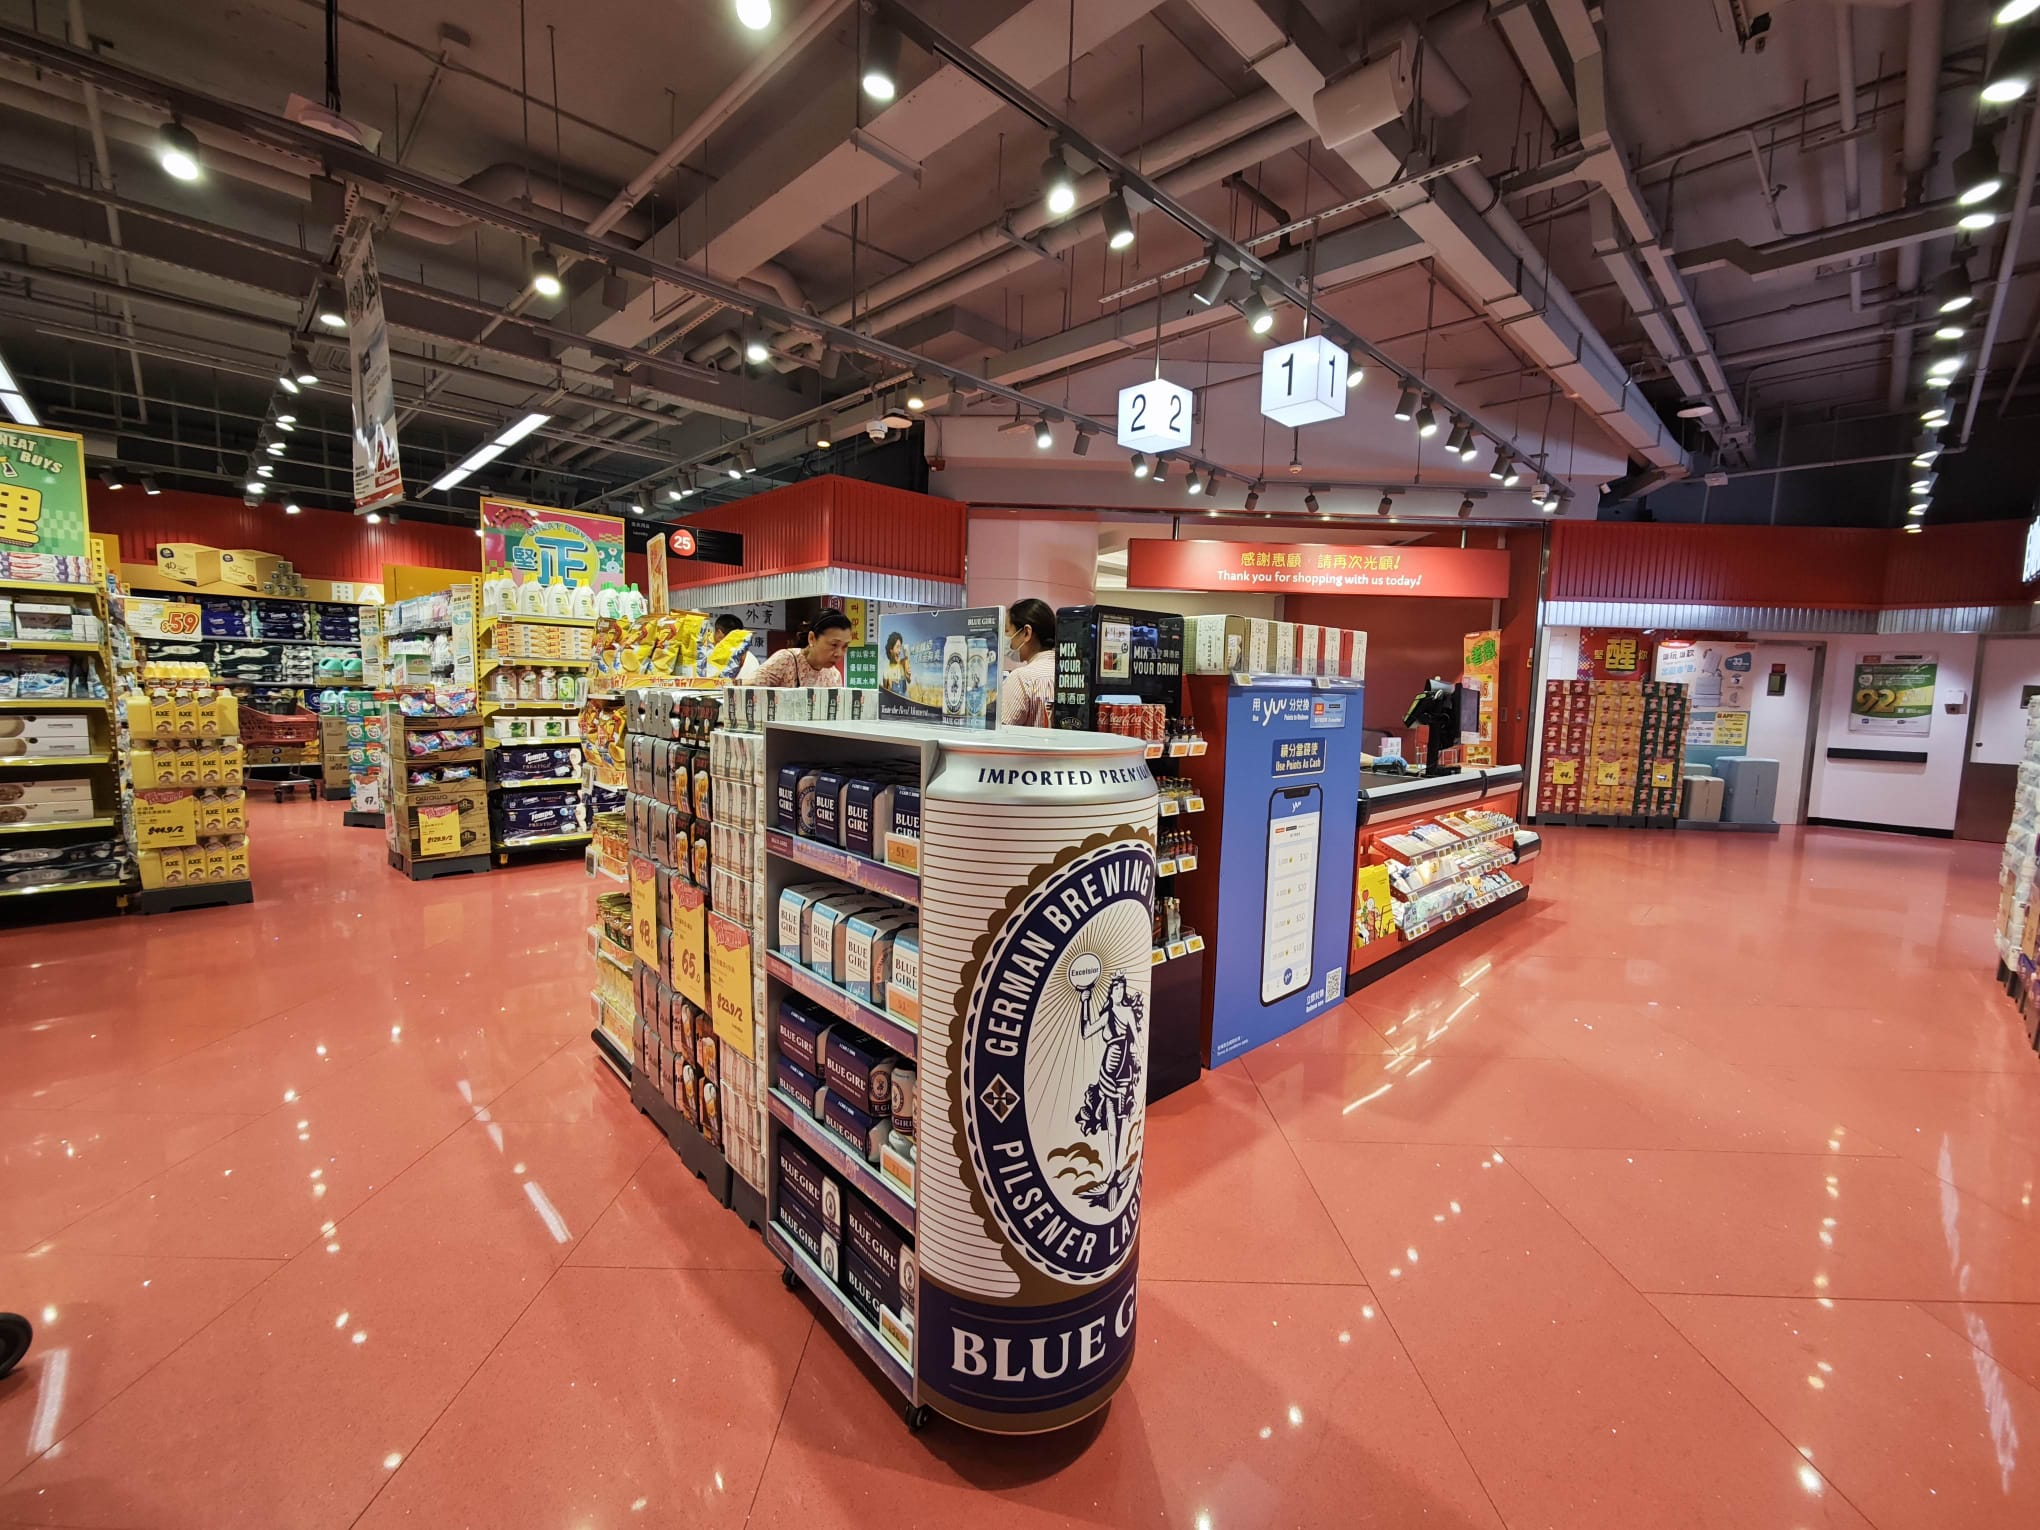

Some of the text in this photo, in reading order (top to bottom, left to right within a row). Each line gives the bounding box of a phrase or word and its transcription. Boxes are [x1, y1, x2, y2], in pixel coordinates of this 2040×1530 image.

[1282, 353, 1294, 396] 1
[1329, 354, 1336, 398] 1
[1131, 394, 1146, 432] 2
[1169, 394, 1182, 432] 2
[20, 451, 63, 473] BUYS
[674, 536, 691, 550] 25
[1241, 552, 1302, 568] 感謝惠顧
[1217, 571, 1422, 588] Thank you for shopping with us today!
[967, 617, 996, 625] BLUE GIRL
[1060, 643, 1076, 657] MIX
[1134, 646, 1148, 659] MIX
[1059, 660, 1080, 673] YOUR
[1134, 662, 1179, 675] YOUR DRINK
[1059, 674, 1085, 688] DRINK
[1857, 688, 1896, 713] 92
[1253, 698, 1261, 711] 用
[1262, 697, 1287, 727] yuu
[523, 752, 549, 765] Tempo
[1276, 758, 1321, 771] Use Points As Cash
[978, 768, 1093, 786] IMPORTED
[779, 787, 793, 800] BLUE
[779, 799, 793, 812] GIRL
[817, 796, 834, 810] BLUE
[529, 810, 556, 823] Tempo
[817, 808, 834, 822] GIRL
[848, 805, 868, 820] BLUE
[896, 813, 920, 828] BLUE
[848, 818, 868, 833] GIRL
[781, 910, 797, 924] BLUE
[781, 922, 797, 936] GIRL
[814, 924, 829, 938] BLUE
[814, 937, 829, 952] GIRL
[848, 941, 867, 958] BLUE
[848, 954, 867, 970] GIRL
[896, 958, 917, 974] BLUE
[985, 859, 1151, 1057] GERMAN BREWING
[1071, 967, 1099, 977] Excelsior
[896, 973, 917, 990] GIRL
[780, 1025, 814, 1054] BLUE GIRL
[827, 1058, 846, 1078] BLUE
[845, 1071, 866, 1091] GIRL
[779, 1078, 812, 1109] BLUE GIRL
[826, 1113, 864, 1151] BLUE GIRL
[780, 1155, 800, 1183] BLUE
[799, 1175, 820, 1201] GIRL
[993, 1139, 1097, 1264] PILSENER
[780, 1206, 799, 1234] BLUE
[798, 1227, 819, 1256] GIRL
[849, 1213, 897, 1270] BLUE GIRL
[849, 1270, 872, 1305] BLUE
[952, 1317, 1106, 1383] BLUE
